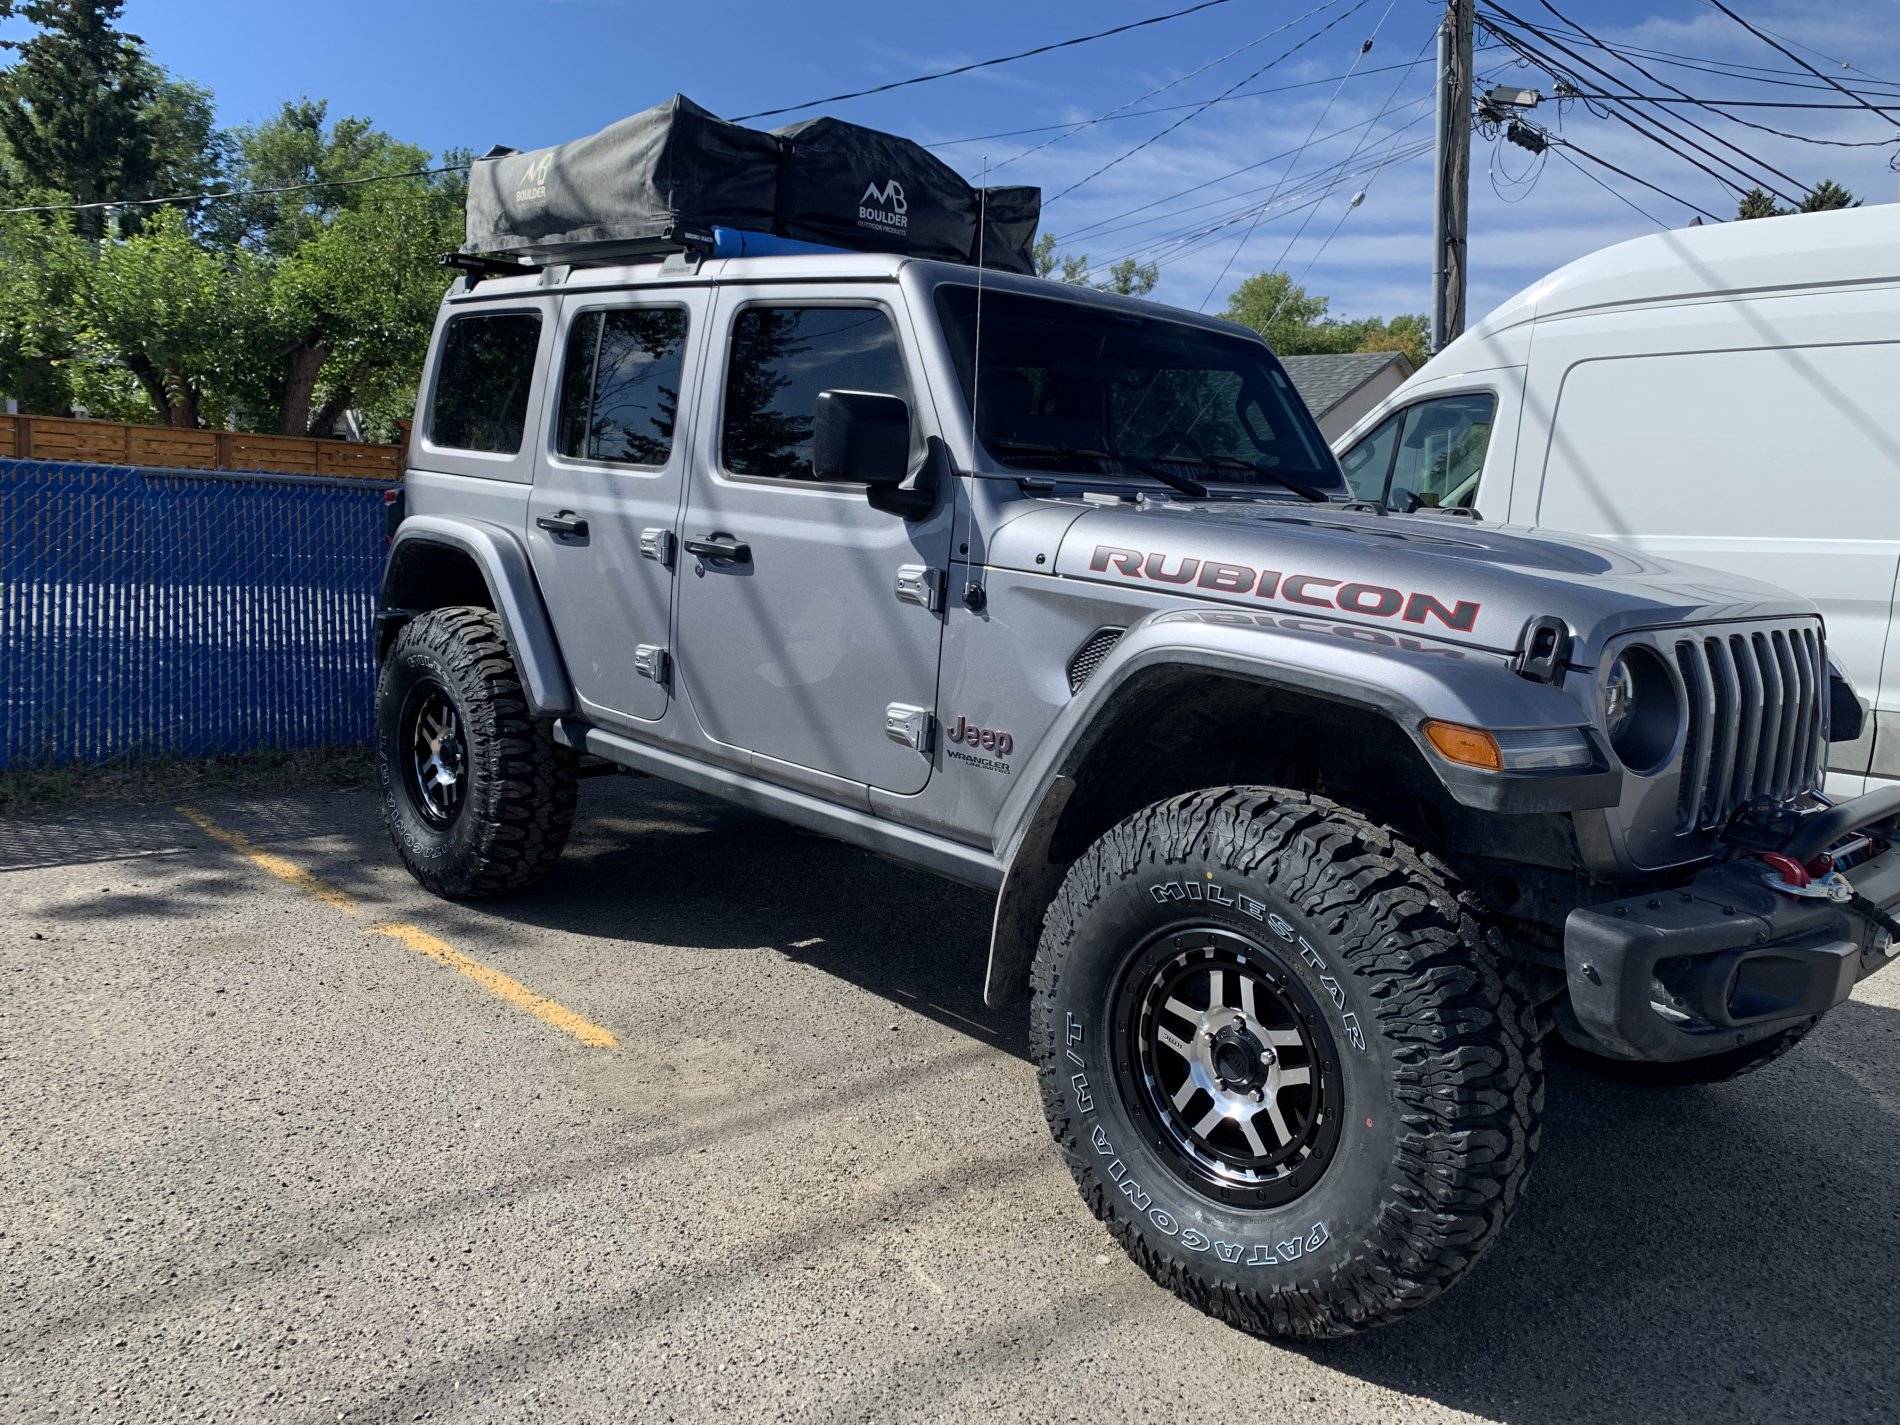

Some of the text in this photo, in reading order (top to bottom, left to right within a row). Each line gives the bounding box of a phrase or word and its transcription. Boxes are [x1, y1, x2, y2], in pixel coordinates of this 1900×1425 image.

[516, 185, 546, 202] BOULDER
[859, 206, 908, 228] BOULDER
[1089, 544, 1482, 633] RUBICON
[947, 714, 1014, 759] Jeep
[946, 749, 1010, 771] WRANGLER
[965, 761, 1011, 775] UNLIMITED
[1150, 881, 1366, 1051] MILESTAR
[1065, 1011, 1095, 1113] M/T
[1091, 1124, 1330, 1266] PATAGONIA
